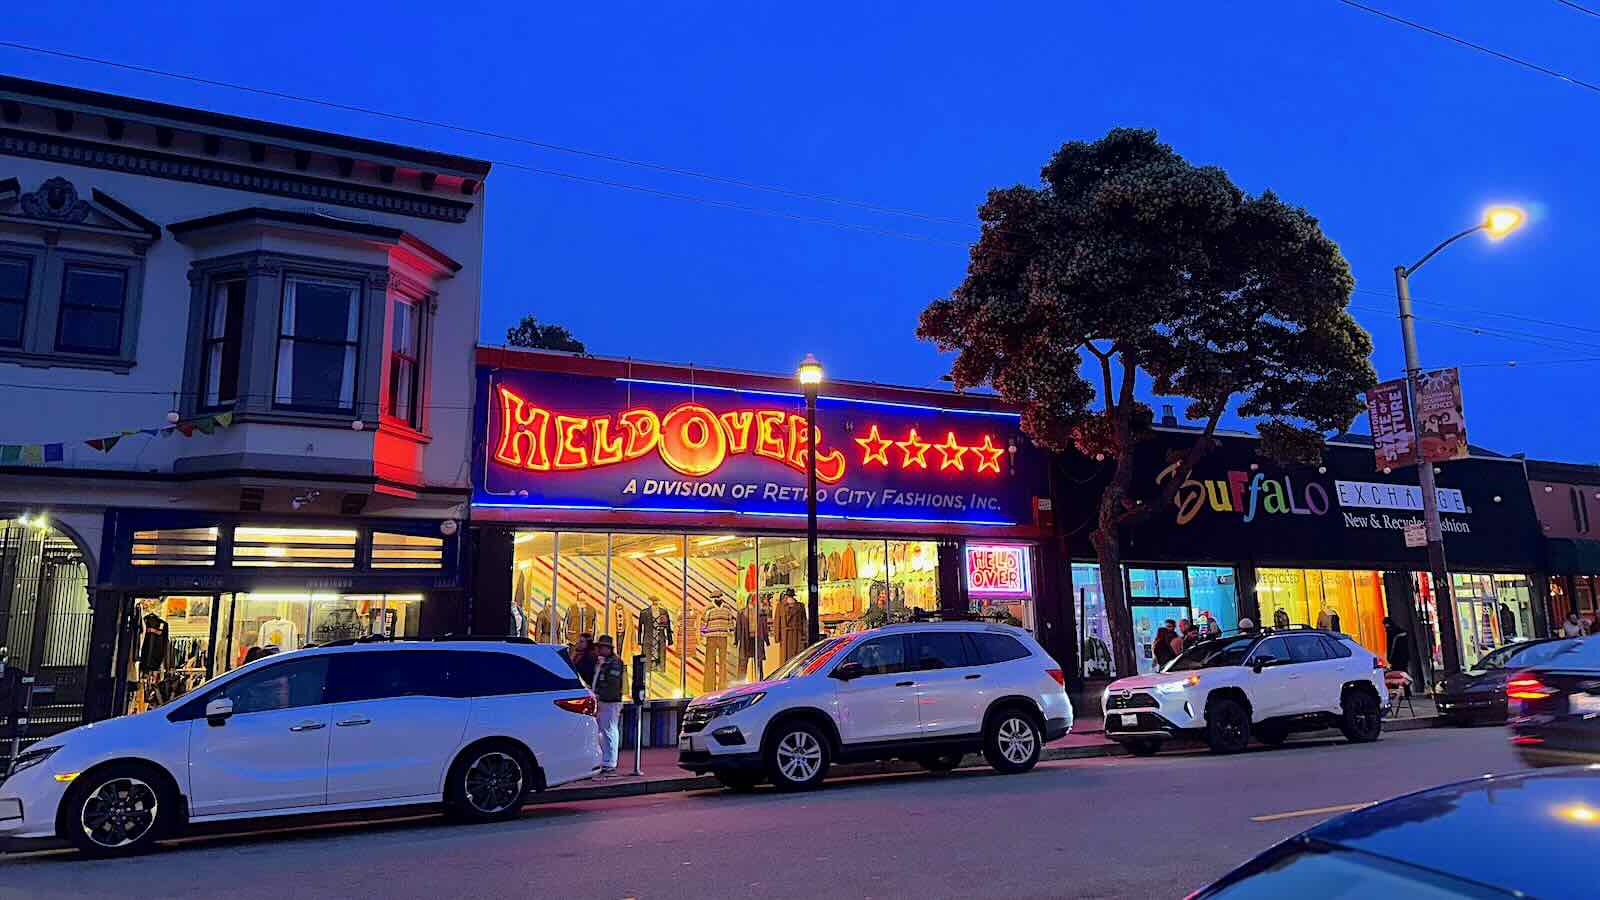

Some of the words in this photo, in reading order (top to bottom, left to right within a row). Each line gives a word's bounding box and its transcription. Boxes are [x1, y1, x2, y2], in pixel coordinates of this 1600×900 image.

[496, 384, 660, 471] HELD
[1379, 414, 1398, 461] STATE
[1389, 391, 1410, 454] NATURE
[623, 480, 637, 494] A
[643, 480, 726, 497] DIVISION
[731, 484, 757, 498] OF
[881, 488, 966, 511] FASHIONS,
[970, 493, 1001, 511] INC.
[1337, 483, 1466, 512] EXCHAGE
[1343, 512, 1368, 528] New
[1370, 514, 1382, 529] &
[973, 551, 1018, 569] HELD
[973, 569, 1019, 590] OVER
